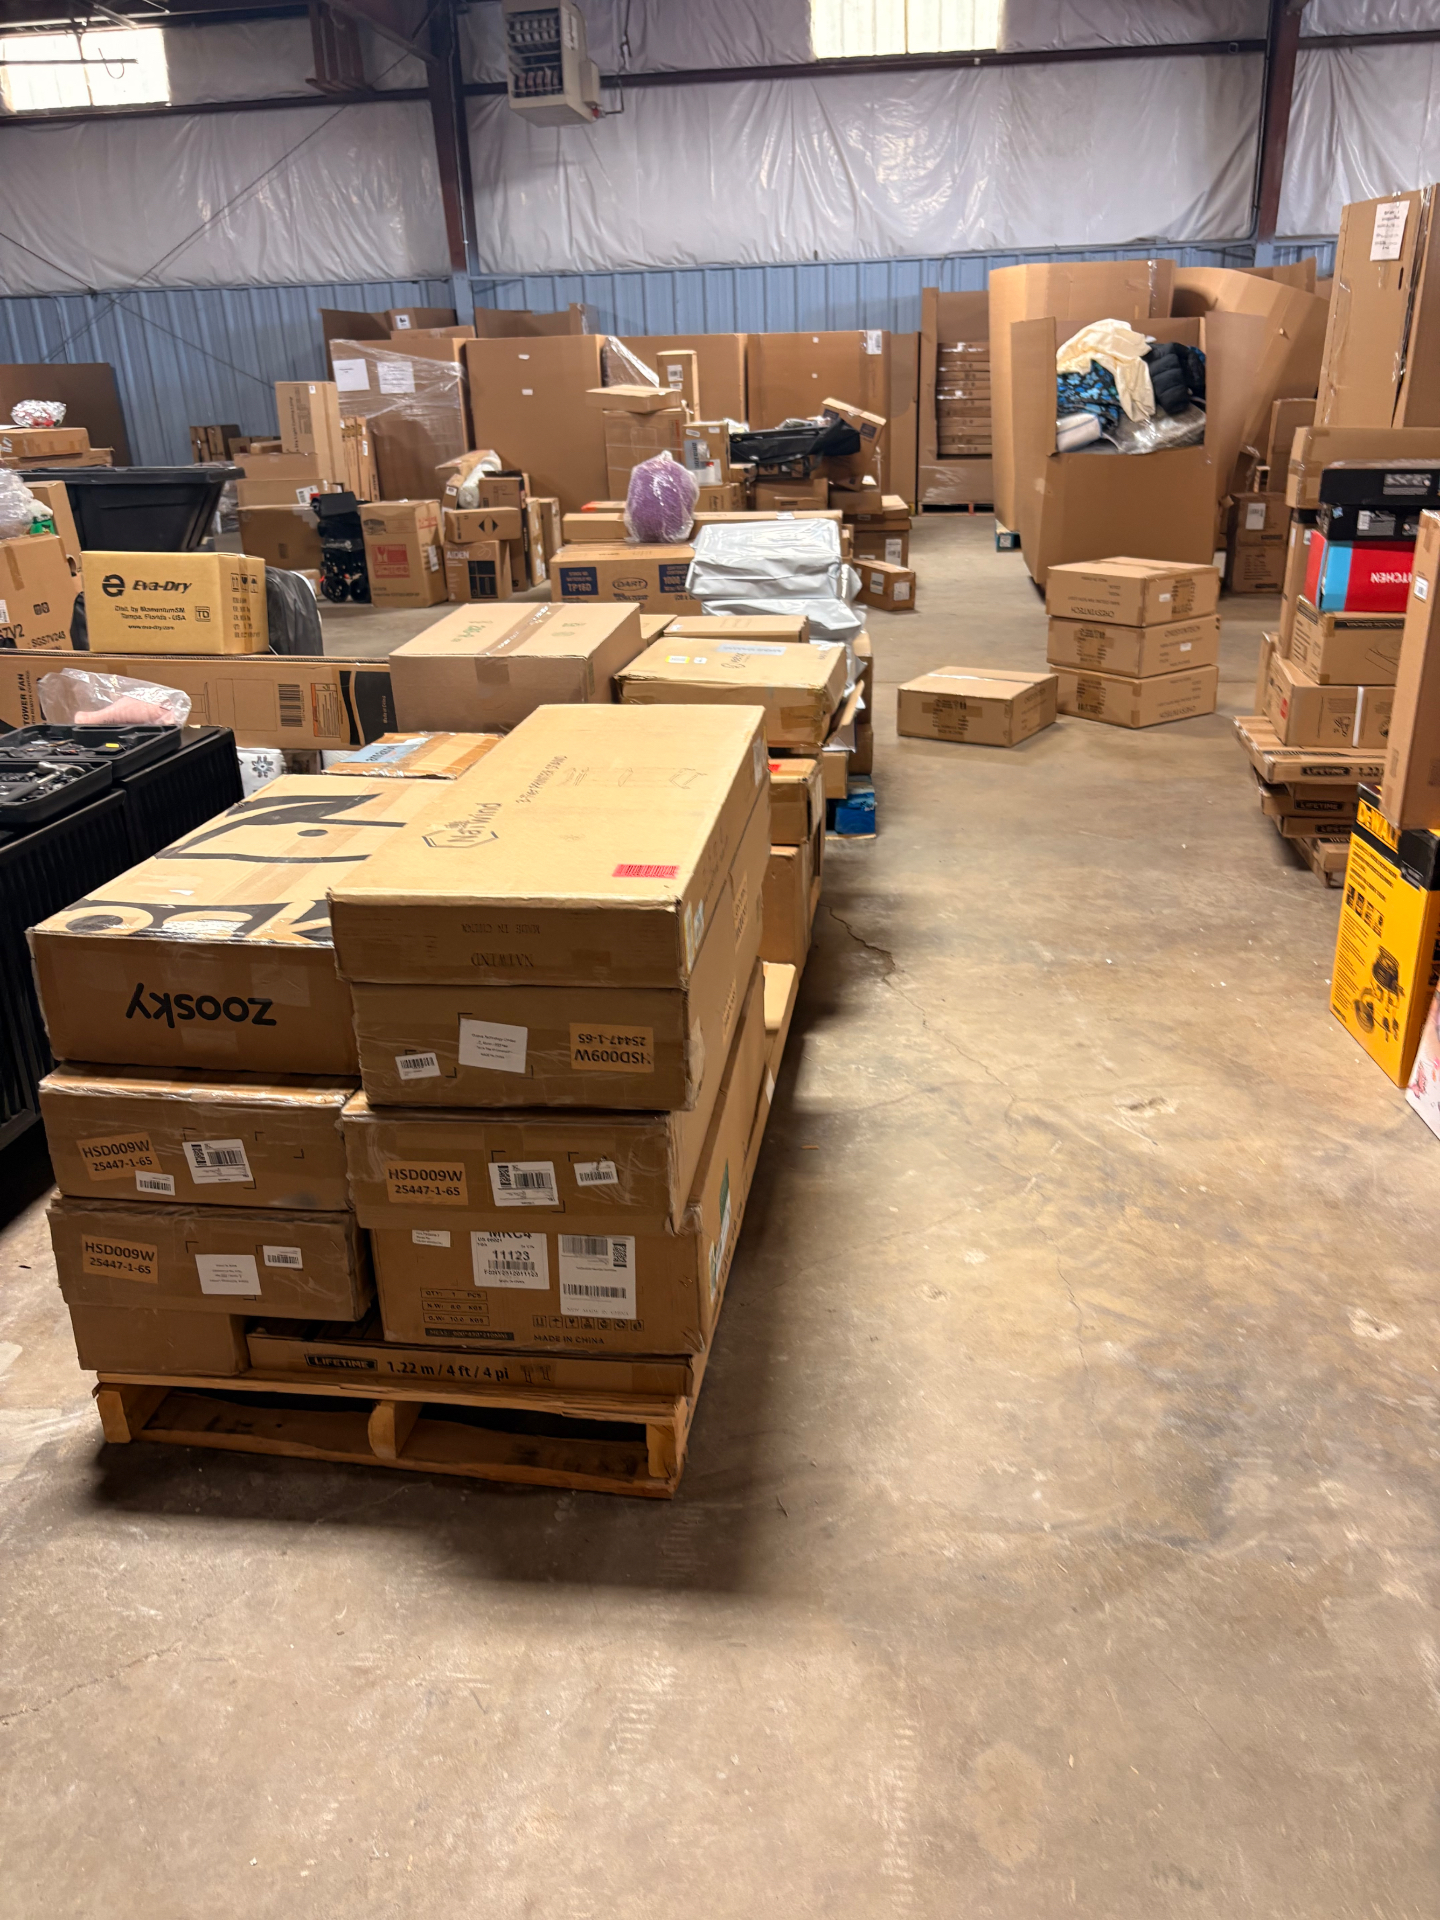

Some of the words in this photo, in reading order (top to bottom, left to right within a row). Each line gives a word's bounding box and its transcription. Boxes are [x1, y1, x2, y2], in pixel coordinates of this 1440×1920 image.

[447, 550, 470, 559] AIDEN
[618, 580, 644, 588] DART
[1370, 572, 1412, 584] ITCHEN
[132, 579, 192, 594] Eva-Dry
[18, 673, 26, 691] FAN
[20, 694, 30, 726] TOWER
[126, 982, 277, 1029] zoosky
[578, 1032, 646, 1047] 25447-1-65
[574, 1049, 651, 1065] HSD009W
[82, 1140, 150, 1158] HSD009W
[92, 1156, 152, 1172] 25447-1-65
[388, 1168, 463, 1182] HSD009W
[394, 1185, 461, 1197] 25447-1-65
[85, 1241, 155, 1262] HSD009W
[492, 1250, 530, 1261] 11123
[89, 1256, 152, 1275] 25447-1-65
[534, 1334, 560, 1342] MADE
[576, 1336, 605, 1345] CHINA
[314, 1356, 369, 1369] LIFETIME
[386, 1360, 418, 1374] 1.22
[420, 1365, 435, 1376] m
[446, 1364, 456, 1377] 4
[458, 1364, 472, 1378] ft
[483, 1366, 492, 1378] 4
[495, 1366, 510, 1382] pi
